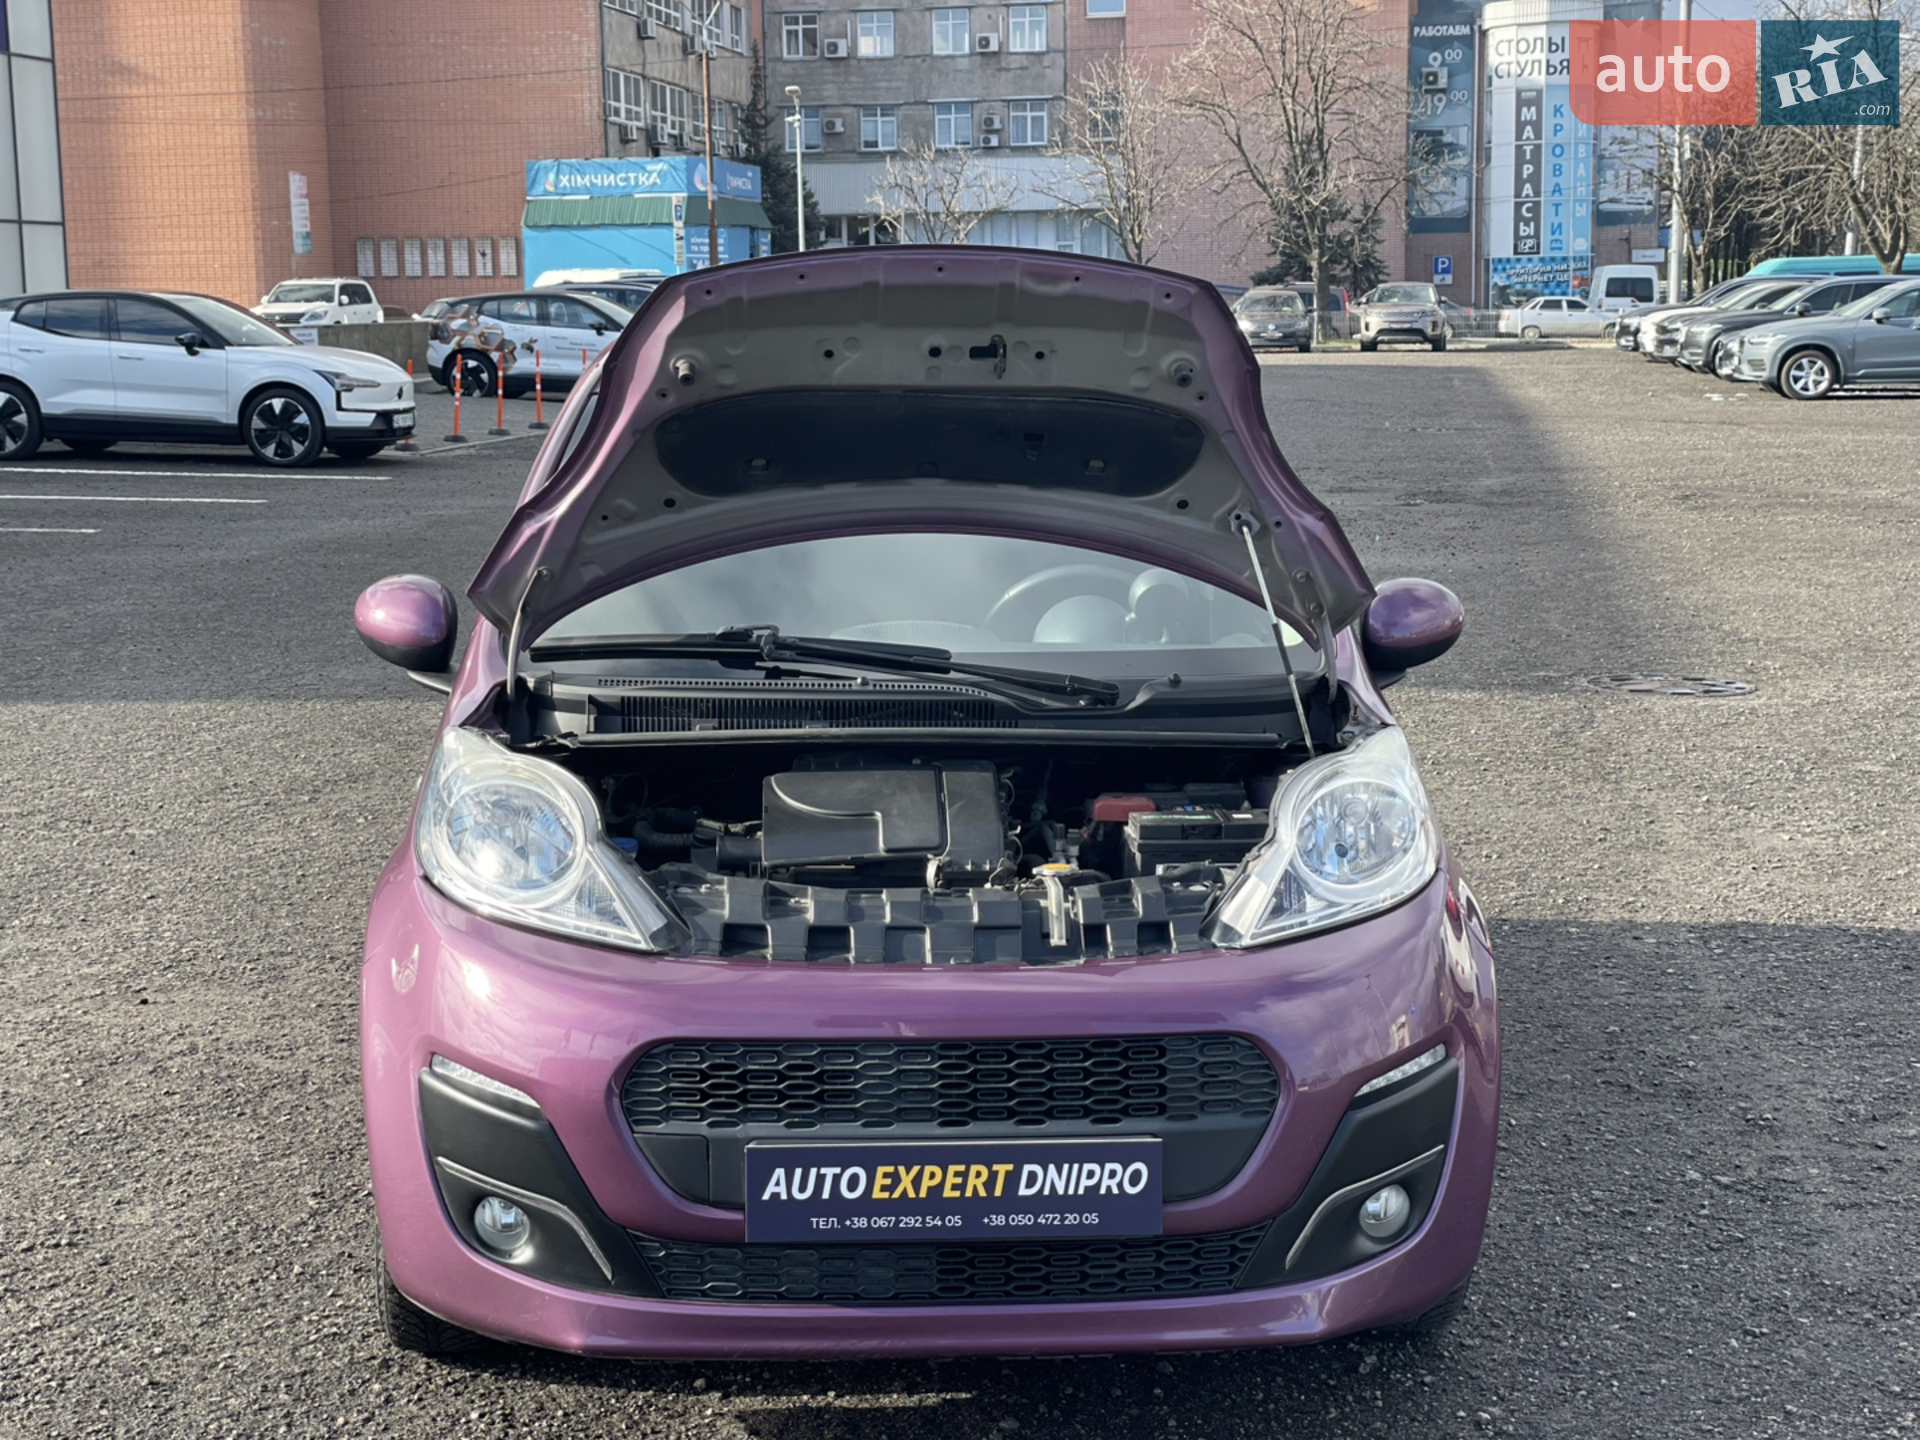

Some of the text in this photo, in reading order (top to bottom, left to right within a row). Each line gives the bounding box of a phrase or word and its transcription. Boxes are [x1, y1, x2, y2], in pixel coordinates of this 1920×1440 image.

[1413, 24, 1472, 37] РАБОТАЕМ
[1495, 36, 1565, 57] СТОЛЫ
[1494, 58, 1570, 79] СТУЛЬЯ
[559, 172, 661, 188] ХІМЧИСТКА
[1520, 105, 1537, 237] МАТРАСЫ
[1551, 103, 1565, 236] КРОВАТИ
[1438, 258, 1449, 273] P
[761, 1161, 1149, 1201] AUTO EXPERT DNIPRO
[810, 1212, 1099, 1229] ТЕЛ. +38 067 292 54 05 +38 050 472 20 05
